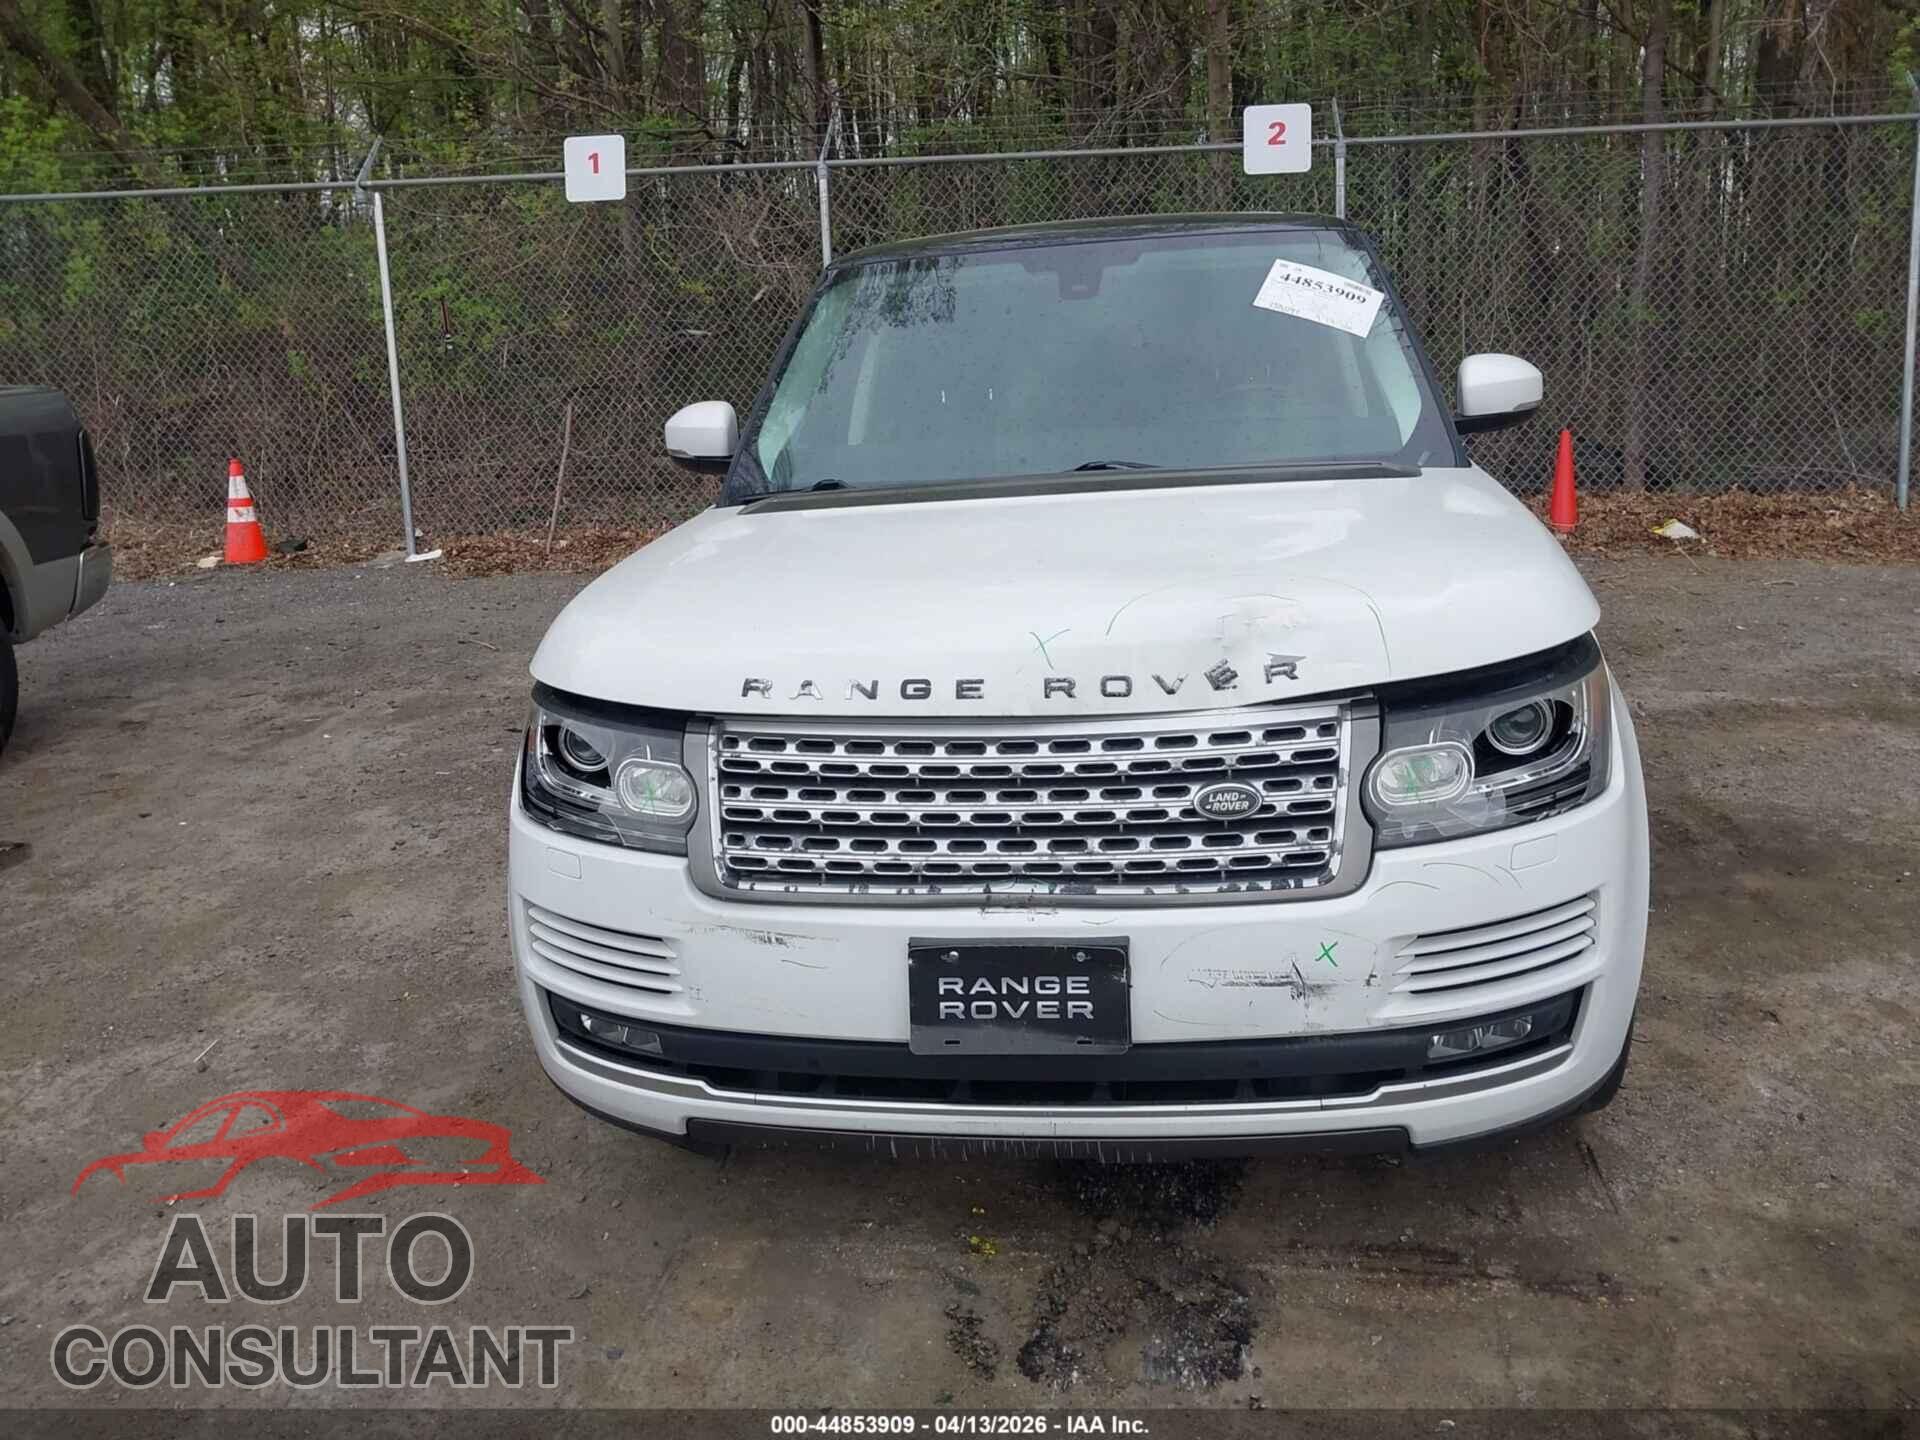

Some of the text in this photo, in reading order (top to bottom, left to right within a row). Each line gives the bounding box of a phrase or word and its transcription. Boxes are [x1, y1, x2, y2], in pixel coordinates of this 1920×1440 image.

[1267, 121, 1287, 146] 2
[587, 152, 600, 174] 1
[1279, 272, 1367, 304] 44853909
[741, 658, 1300, 701] RANGE ROVER
[937, 975, 1092, 995] RANGE
[938, 1000, 1095, 1019] ROVER
